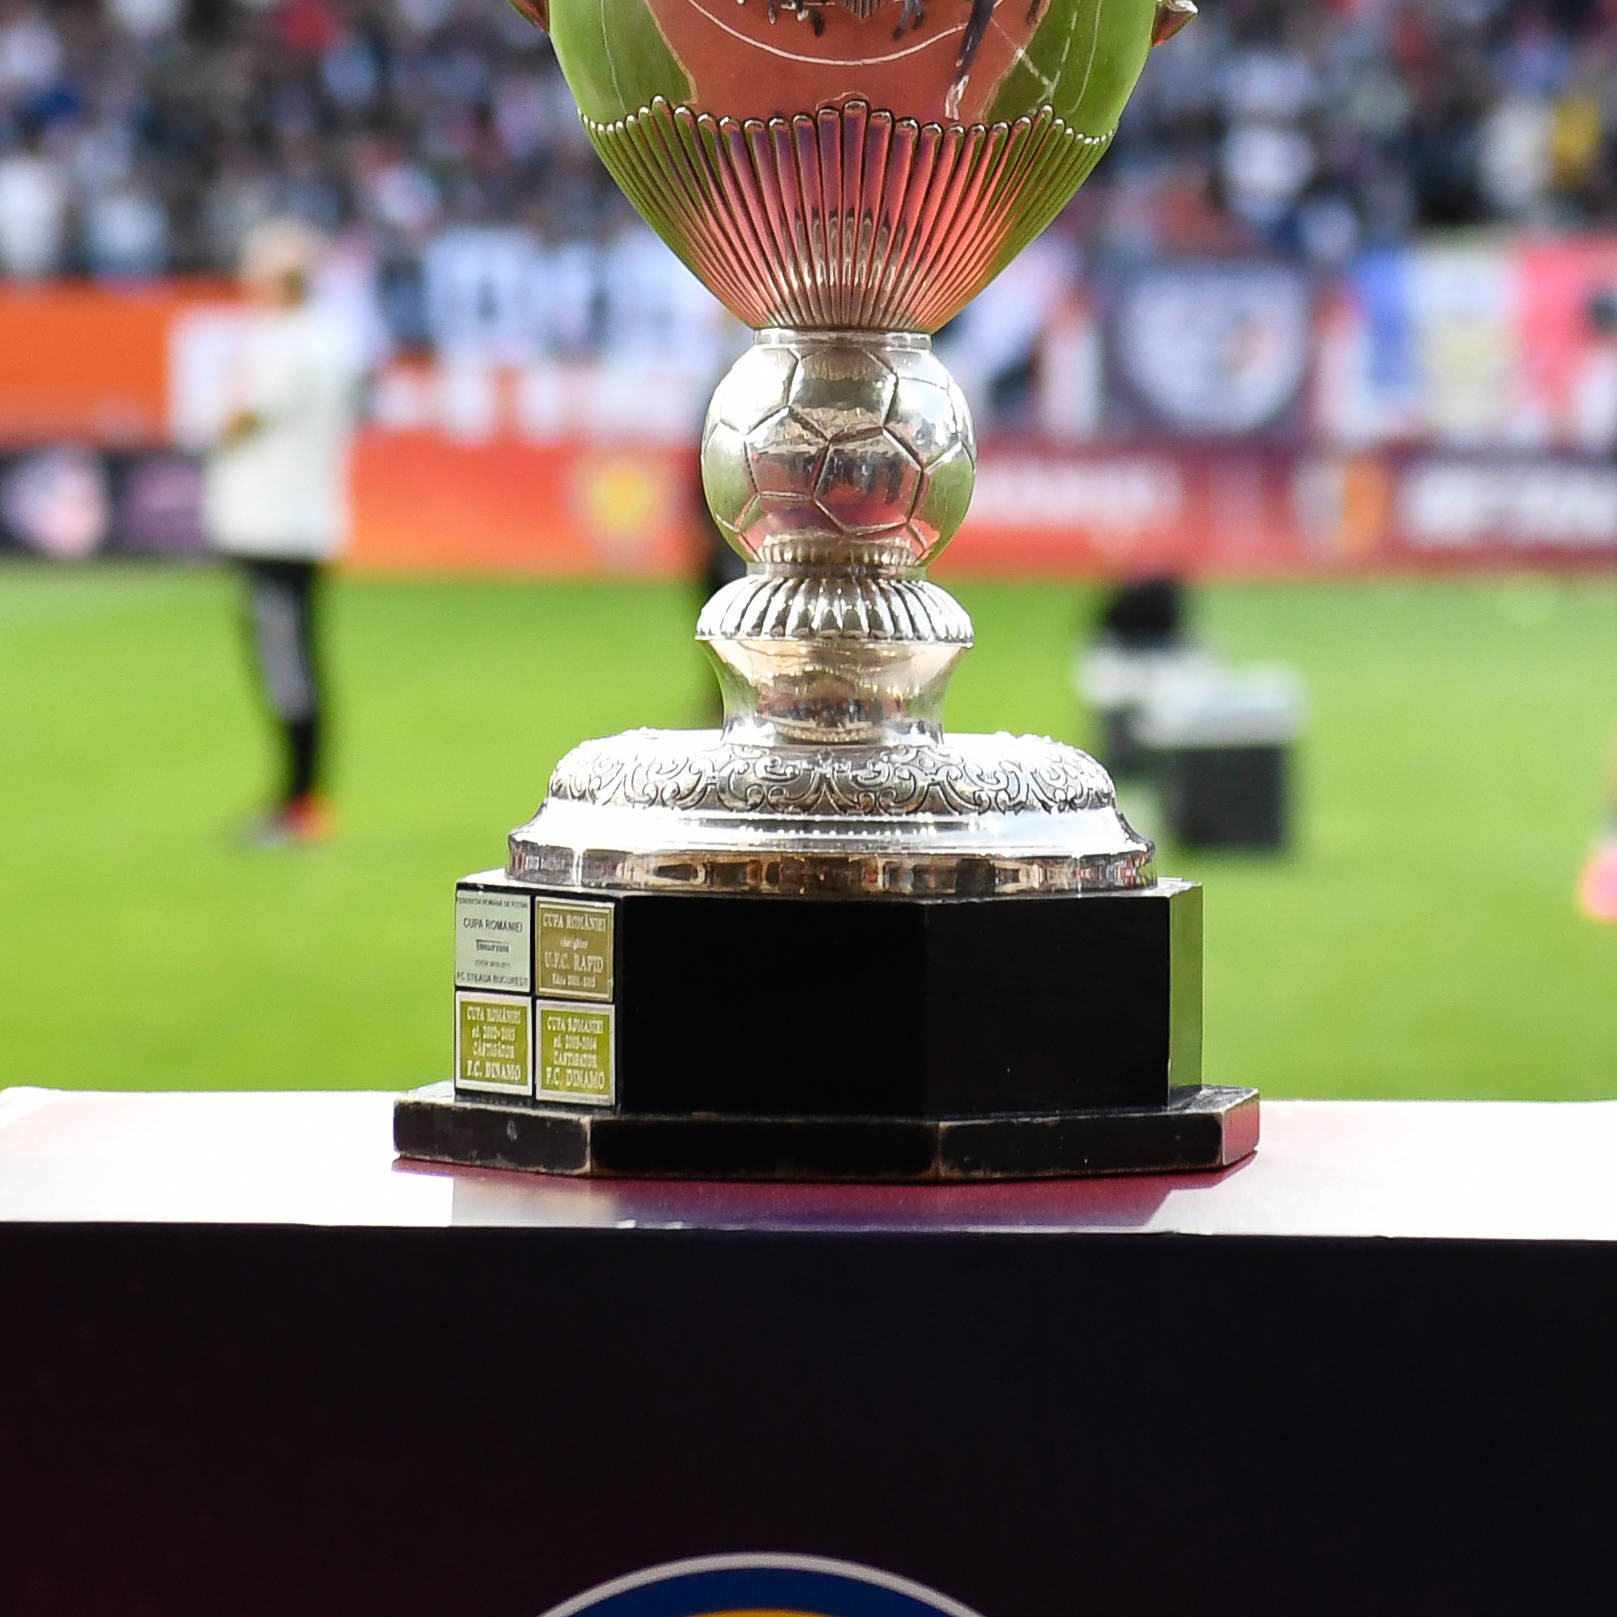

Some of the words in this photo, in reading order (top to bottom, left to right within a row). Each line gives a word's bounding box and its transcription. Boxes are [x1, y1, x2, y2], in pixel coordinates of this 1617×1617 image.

[463, 917, 483, 929] CUPA
[543, 912, 564, 928] CUPA
[573, 952, 604, 974] RAPID
[467, 1006, 485, 1021] CUPA
[547, 1016, 566, 1031] CUPA
[485, 1061, 521, 1081] DINAMO
[566, 1069, 605, 1090] DINAMO
